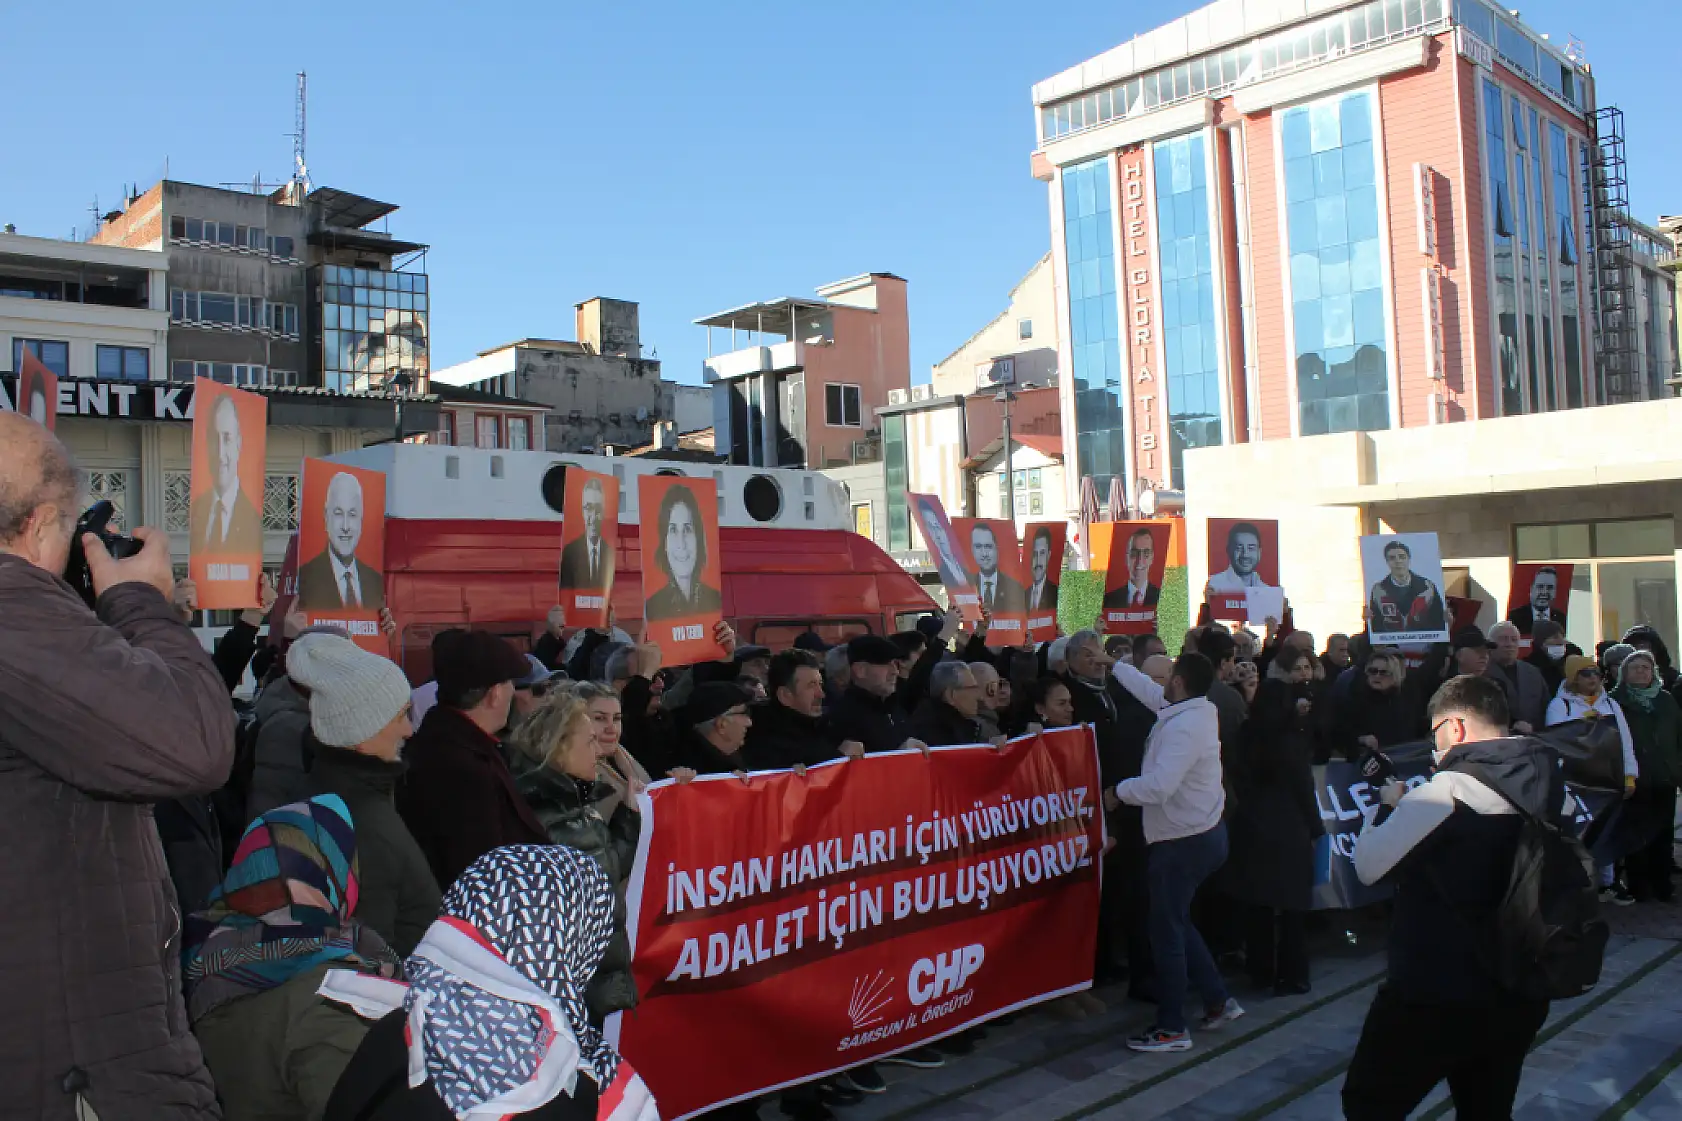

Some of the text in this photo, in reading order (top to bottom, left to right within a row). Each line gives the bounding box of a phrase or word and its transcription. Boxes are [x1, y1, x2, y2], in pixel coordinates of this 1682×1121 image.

[1124, 160, 1146, 256] HOTEL
[1132, 267, 1155, 385] GLORIA
[666, 786, 1095, 915] İNSAN HAKLARI İÇİN YÜRÜYORUZ,
[665, 835, 1093, 982] ADALET İÇİN BULUŞUYORUZ.
[836, 990, 975, 1052] SAMSUN İL ÖRGÜTÜ
[908, 943, 986, 1006] CHP
